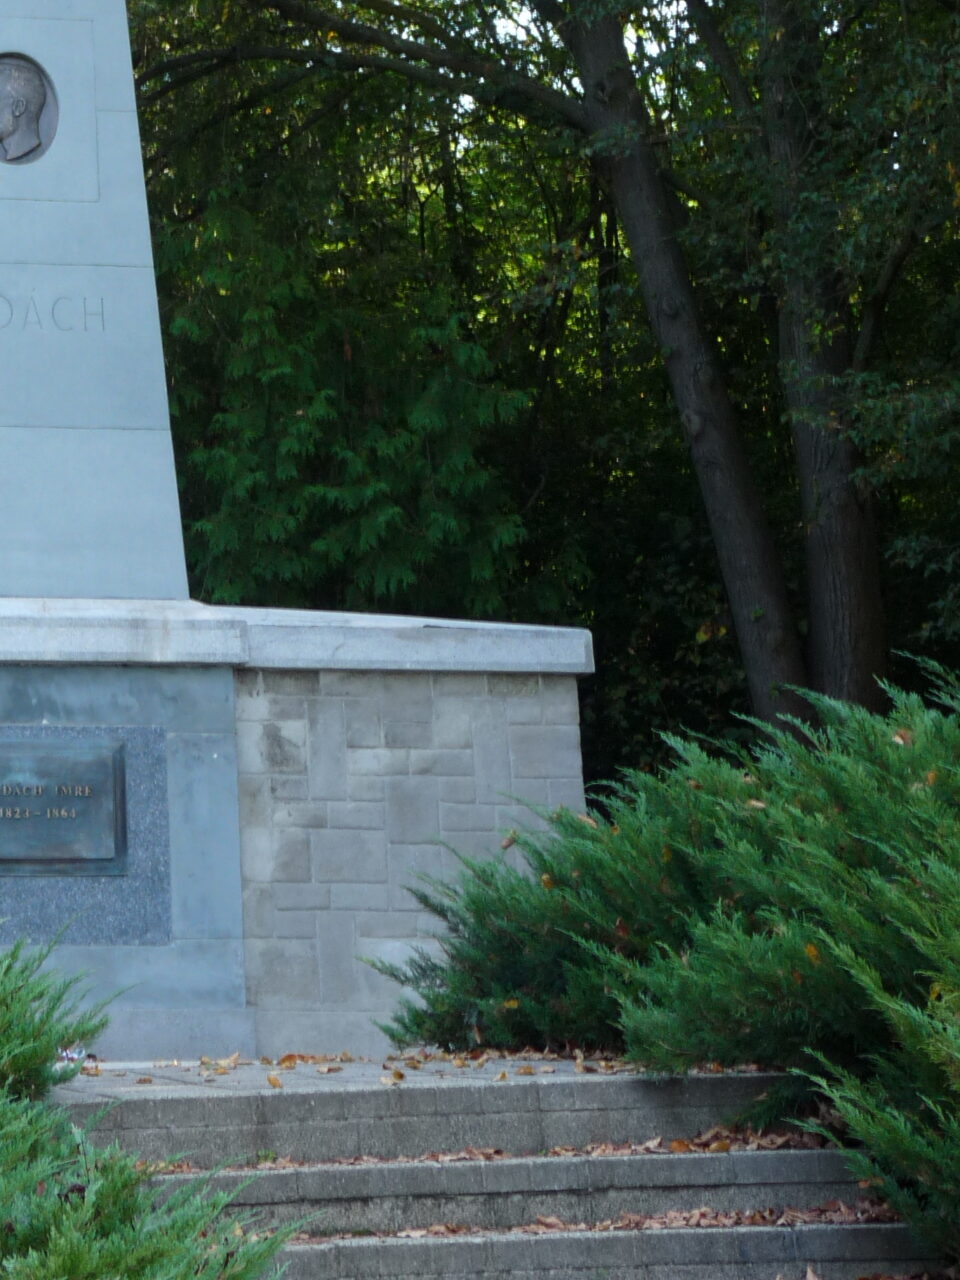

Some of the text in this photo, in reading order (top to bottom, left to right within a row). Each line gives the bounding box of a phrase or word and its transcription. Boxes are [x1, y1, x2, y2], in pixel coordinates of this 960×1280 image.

[54, 783, 94, 798] IMRE
[0, 807, 30, 819] 1823
[47, 807, 77, 819] 1864
